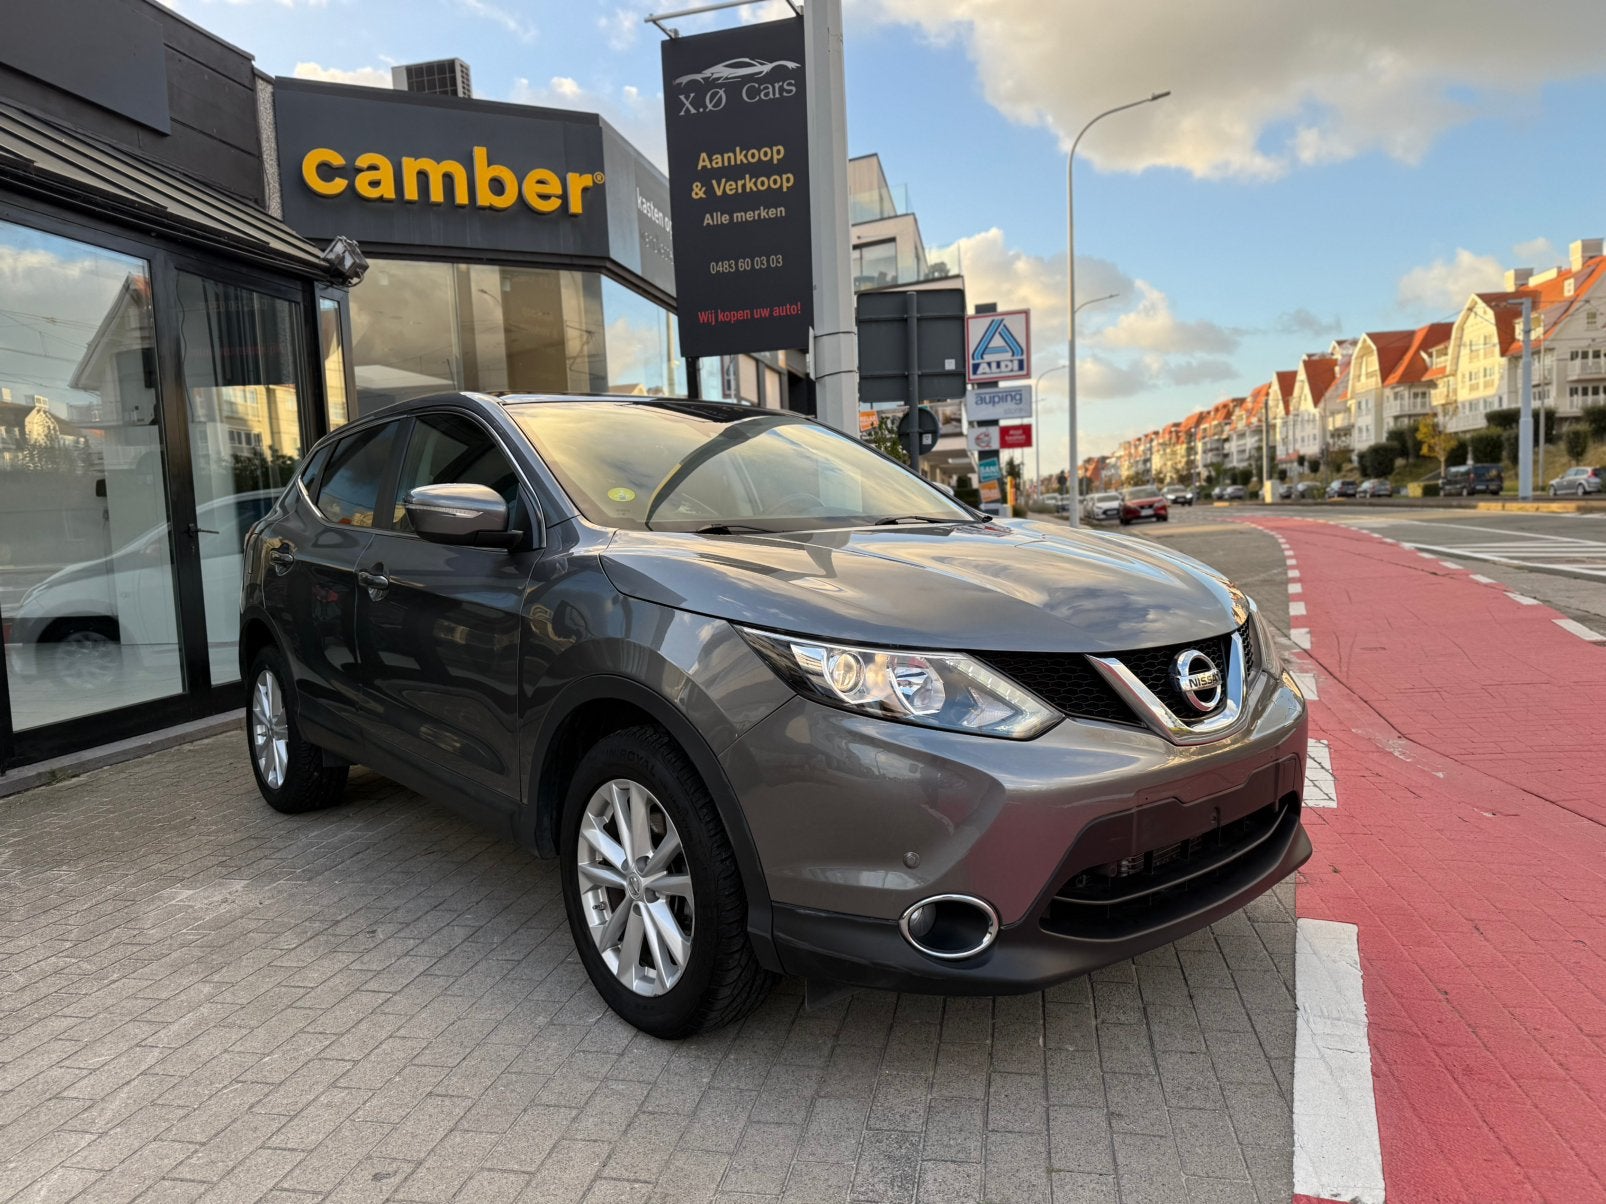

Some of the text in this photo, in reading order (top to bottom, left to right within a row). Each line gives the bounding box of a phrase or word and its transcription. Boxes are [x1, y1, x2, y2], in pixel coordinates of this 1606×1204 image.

[742, 79, 796, 102] Cars
[697, 145, 785, 170] Aankoop
[691, 172, 795, 200] & Verkoop
[636, 187, 664, 228] kasten
[703, 206, 786, 226] Alle merken
[710, 255, 783, 274] 0483 60 03 03
[698, 302, 801, 325] Wij kopen uw auto!
[977, 360, 1019, 375] ALDI
[975, 391, 1023, 407] auping
